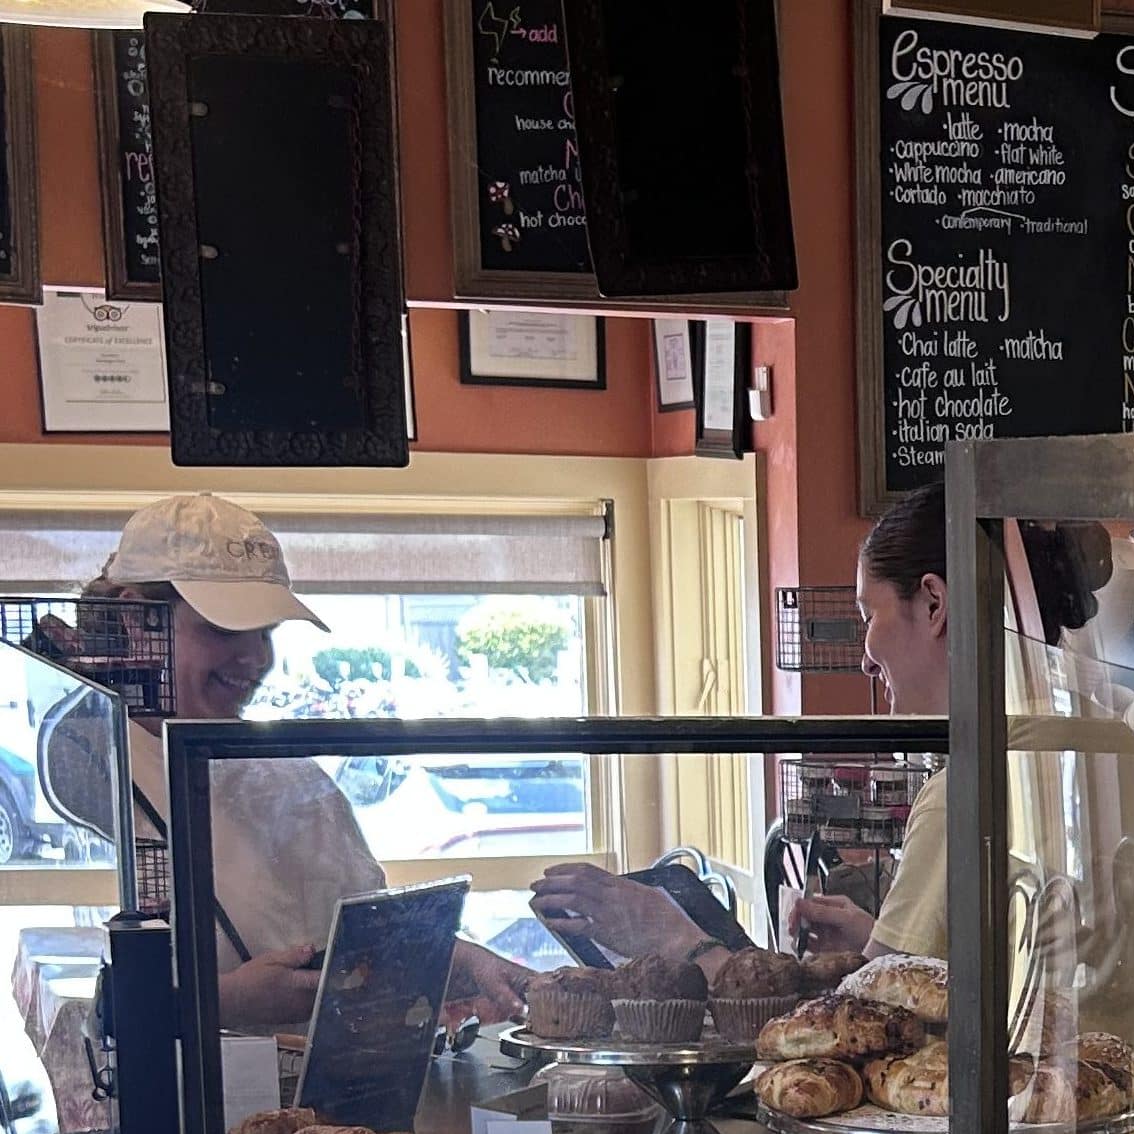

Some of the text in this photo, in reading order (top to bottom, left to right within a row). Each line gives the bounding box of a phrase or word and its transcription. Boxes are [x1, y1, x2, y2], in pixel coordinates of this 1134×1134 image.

[528, 24, 558, 43] add
[942, 77, 1011, 108] menu
[514, 114, 555, 131] house
[946, 112, 984, 141] latte
[1003, 116, 1054, 144] mocha
[1000, 142, 1026, 165] flat
[520, 164, 567, 185] matcha
[935, 162, 982, 185] mocha
[994, 166, 1066, 186] americano
[961, 184, 1036, 207] macchiato
[519, 210, 543, 229] hot
[1025, 216, 1088, 235] traditional
[886, 238, 1010, 322] Specialty
[925, 289, 989, 323] menu
[943, 330, 979, 359] latte
[1004, 328, 1064, 361] matcha
[900, 358, 999, 388] cafe au lait
[898, 387, 1013, 419] hot chocolate
[954, 419, 995, 441] soda
